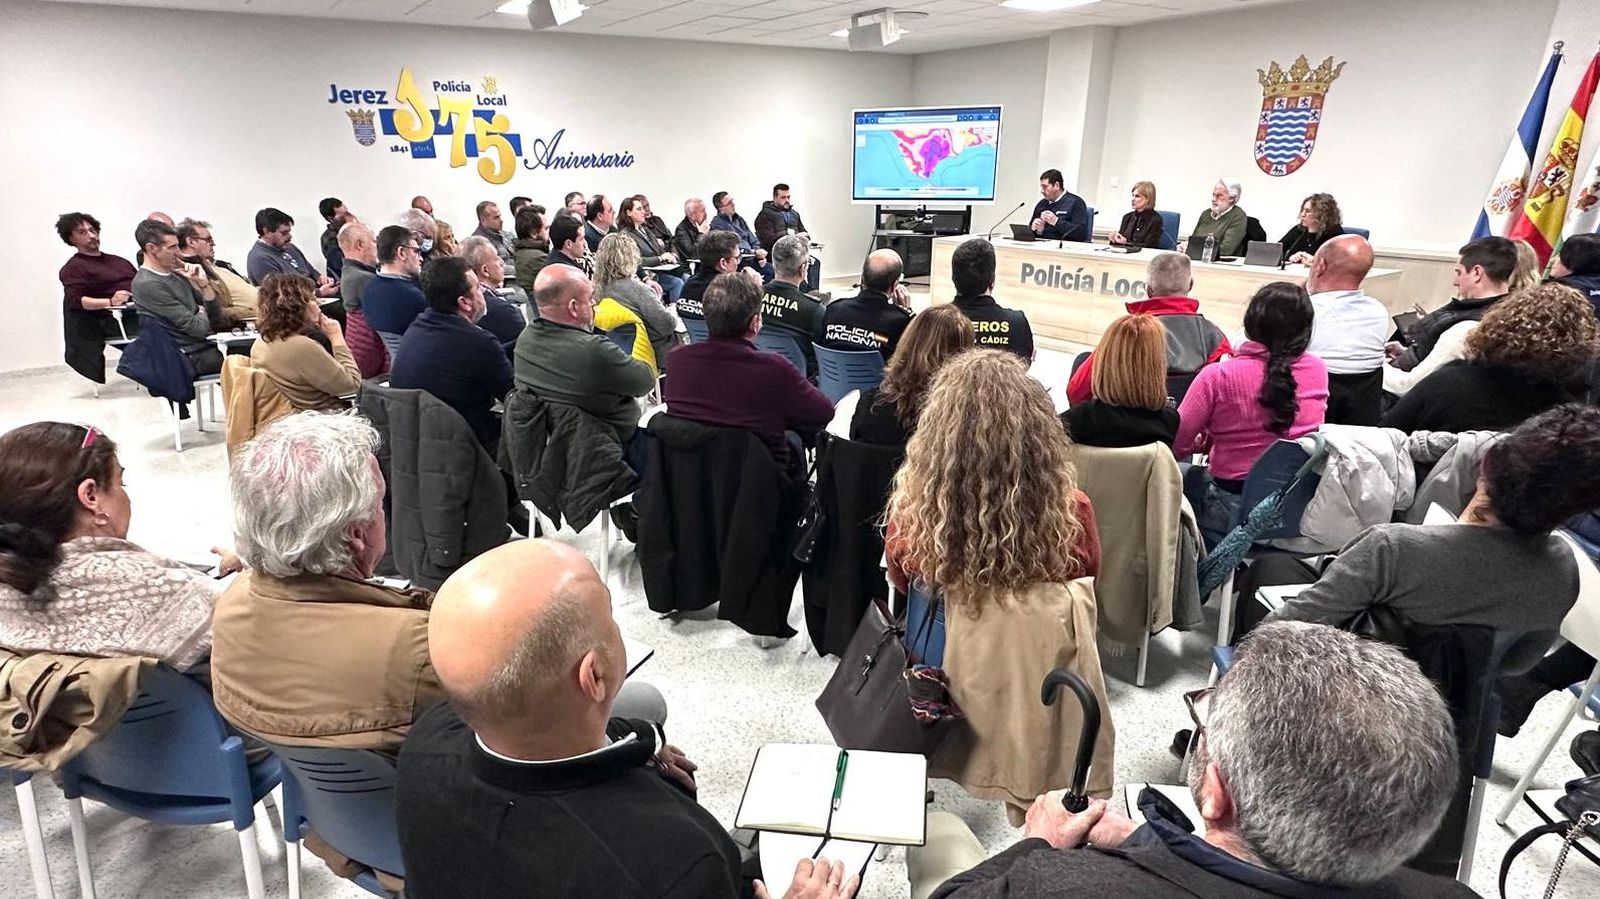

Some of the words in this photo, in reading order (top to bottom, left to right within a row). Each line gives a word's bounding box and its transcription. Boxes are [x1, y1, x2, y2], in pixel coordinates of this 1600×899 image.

[328, 84, 389, 105] Jerez
[476, 94, 507, 107] Local
[390, 144, 409, 154] 1841
[523, 128, 635, 171] Aniversario
[1020, 262, 1095, 294] Policía
[1100, 271, 1145, 300] Loc
[760, 302, 783, 318] IVIL
[761, 292, 799, 312] ARDIA
[826, 324, 875, 340] POLICIA
[971, 320, 1010, 333] EROS
[980, 334, 1009, 345] CÁDIZ
